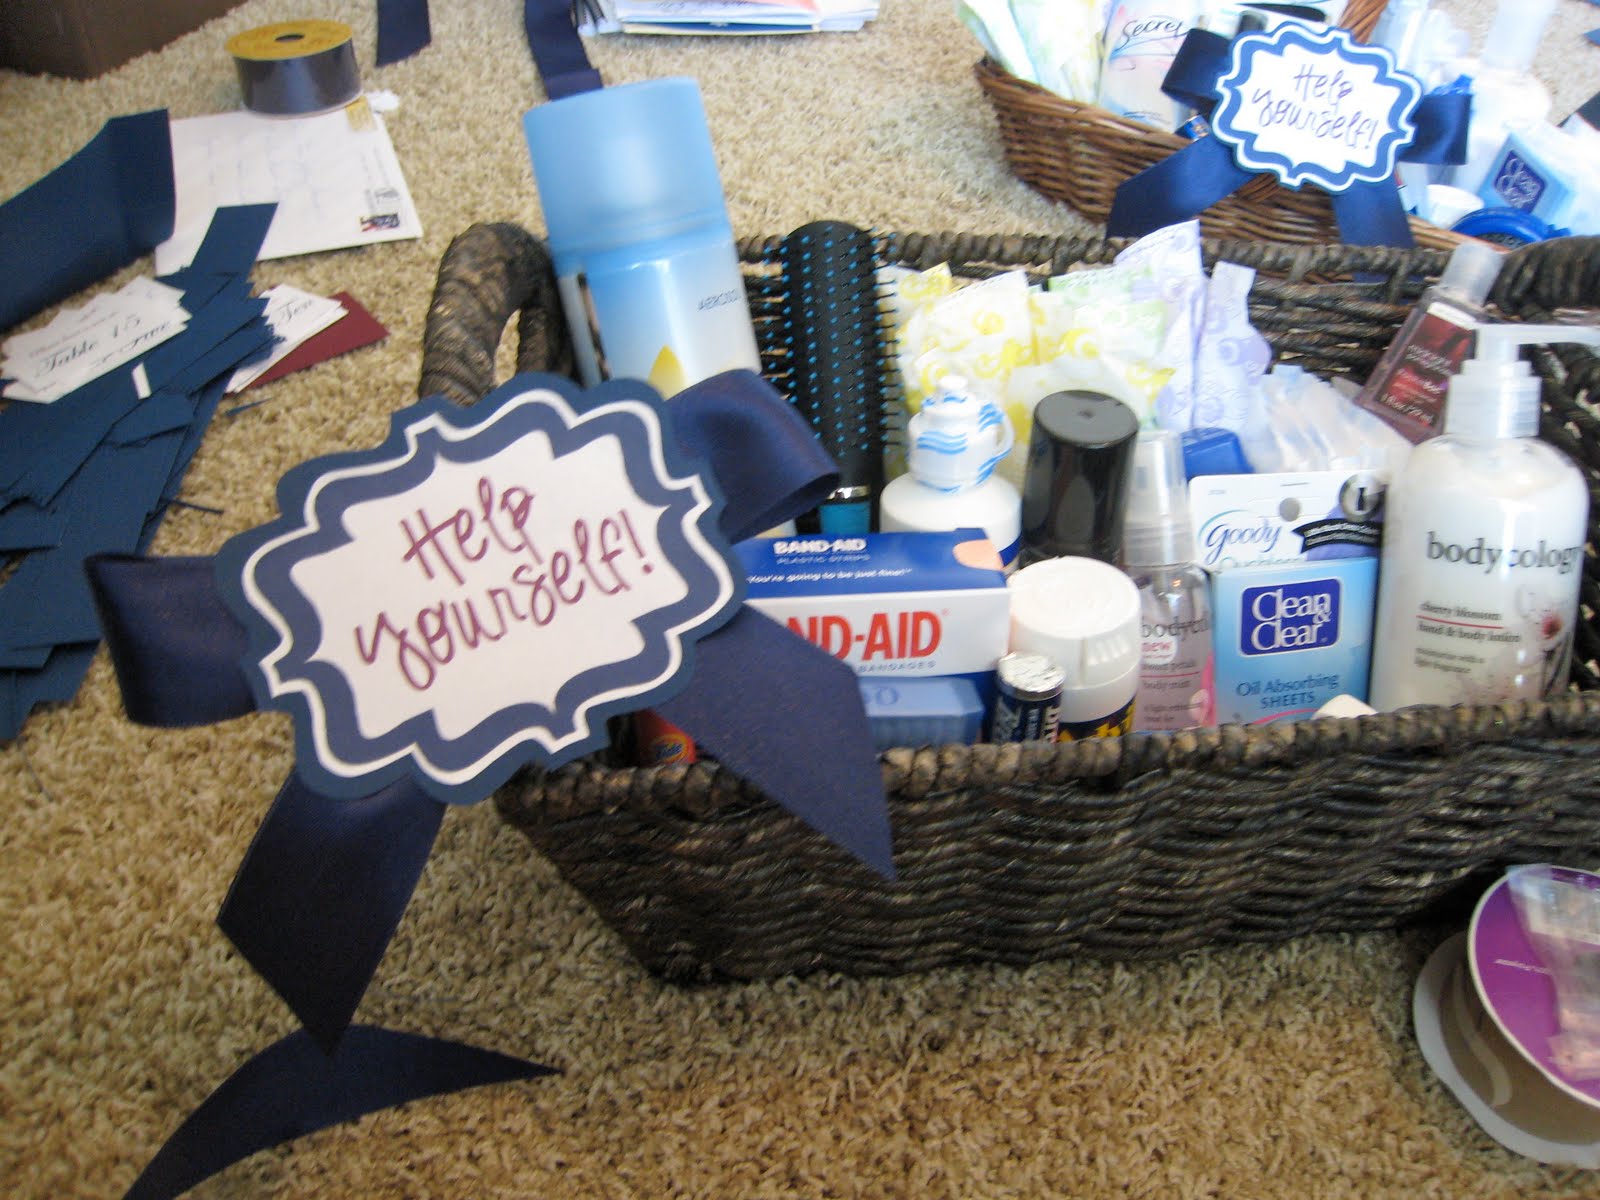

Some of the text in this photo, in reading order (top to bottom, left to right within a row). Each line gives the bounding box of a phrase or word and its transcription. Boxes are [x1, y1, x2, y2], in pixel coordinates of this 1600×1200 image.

[1113, 19, 1185, 53] Secret
[1293, 64, 1354, 115] Help
[1252, 88, 1379, 150] yourself!
[36, 340, 98, 378] Table
[400, 476, 544, 586] Help
[773, 538, 868, 555] BAND-AID
[776, 556, 826, 565] PLASTIC
[354, 509, 655, 691] yourself!
[1251, 588, 1331, 621] Clean
[1312, 611, 1333, 624] &
[787, 611, 943, 661] ND-AID
[1251, 619, 1323, 650] Clear
[1236, 673, 1339, 696] Oil Absorbing
[1260, 691, 1315, 709] SHEETS
